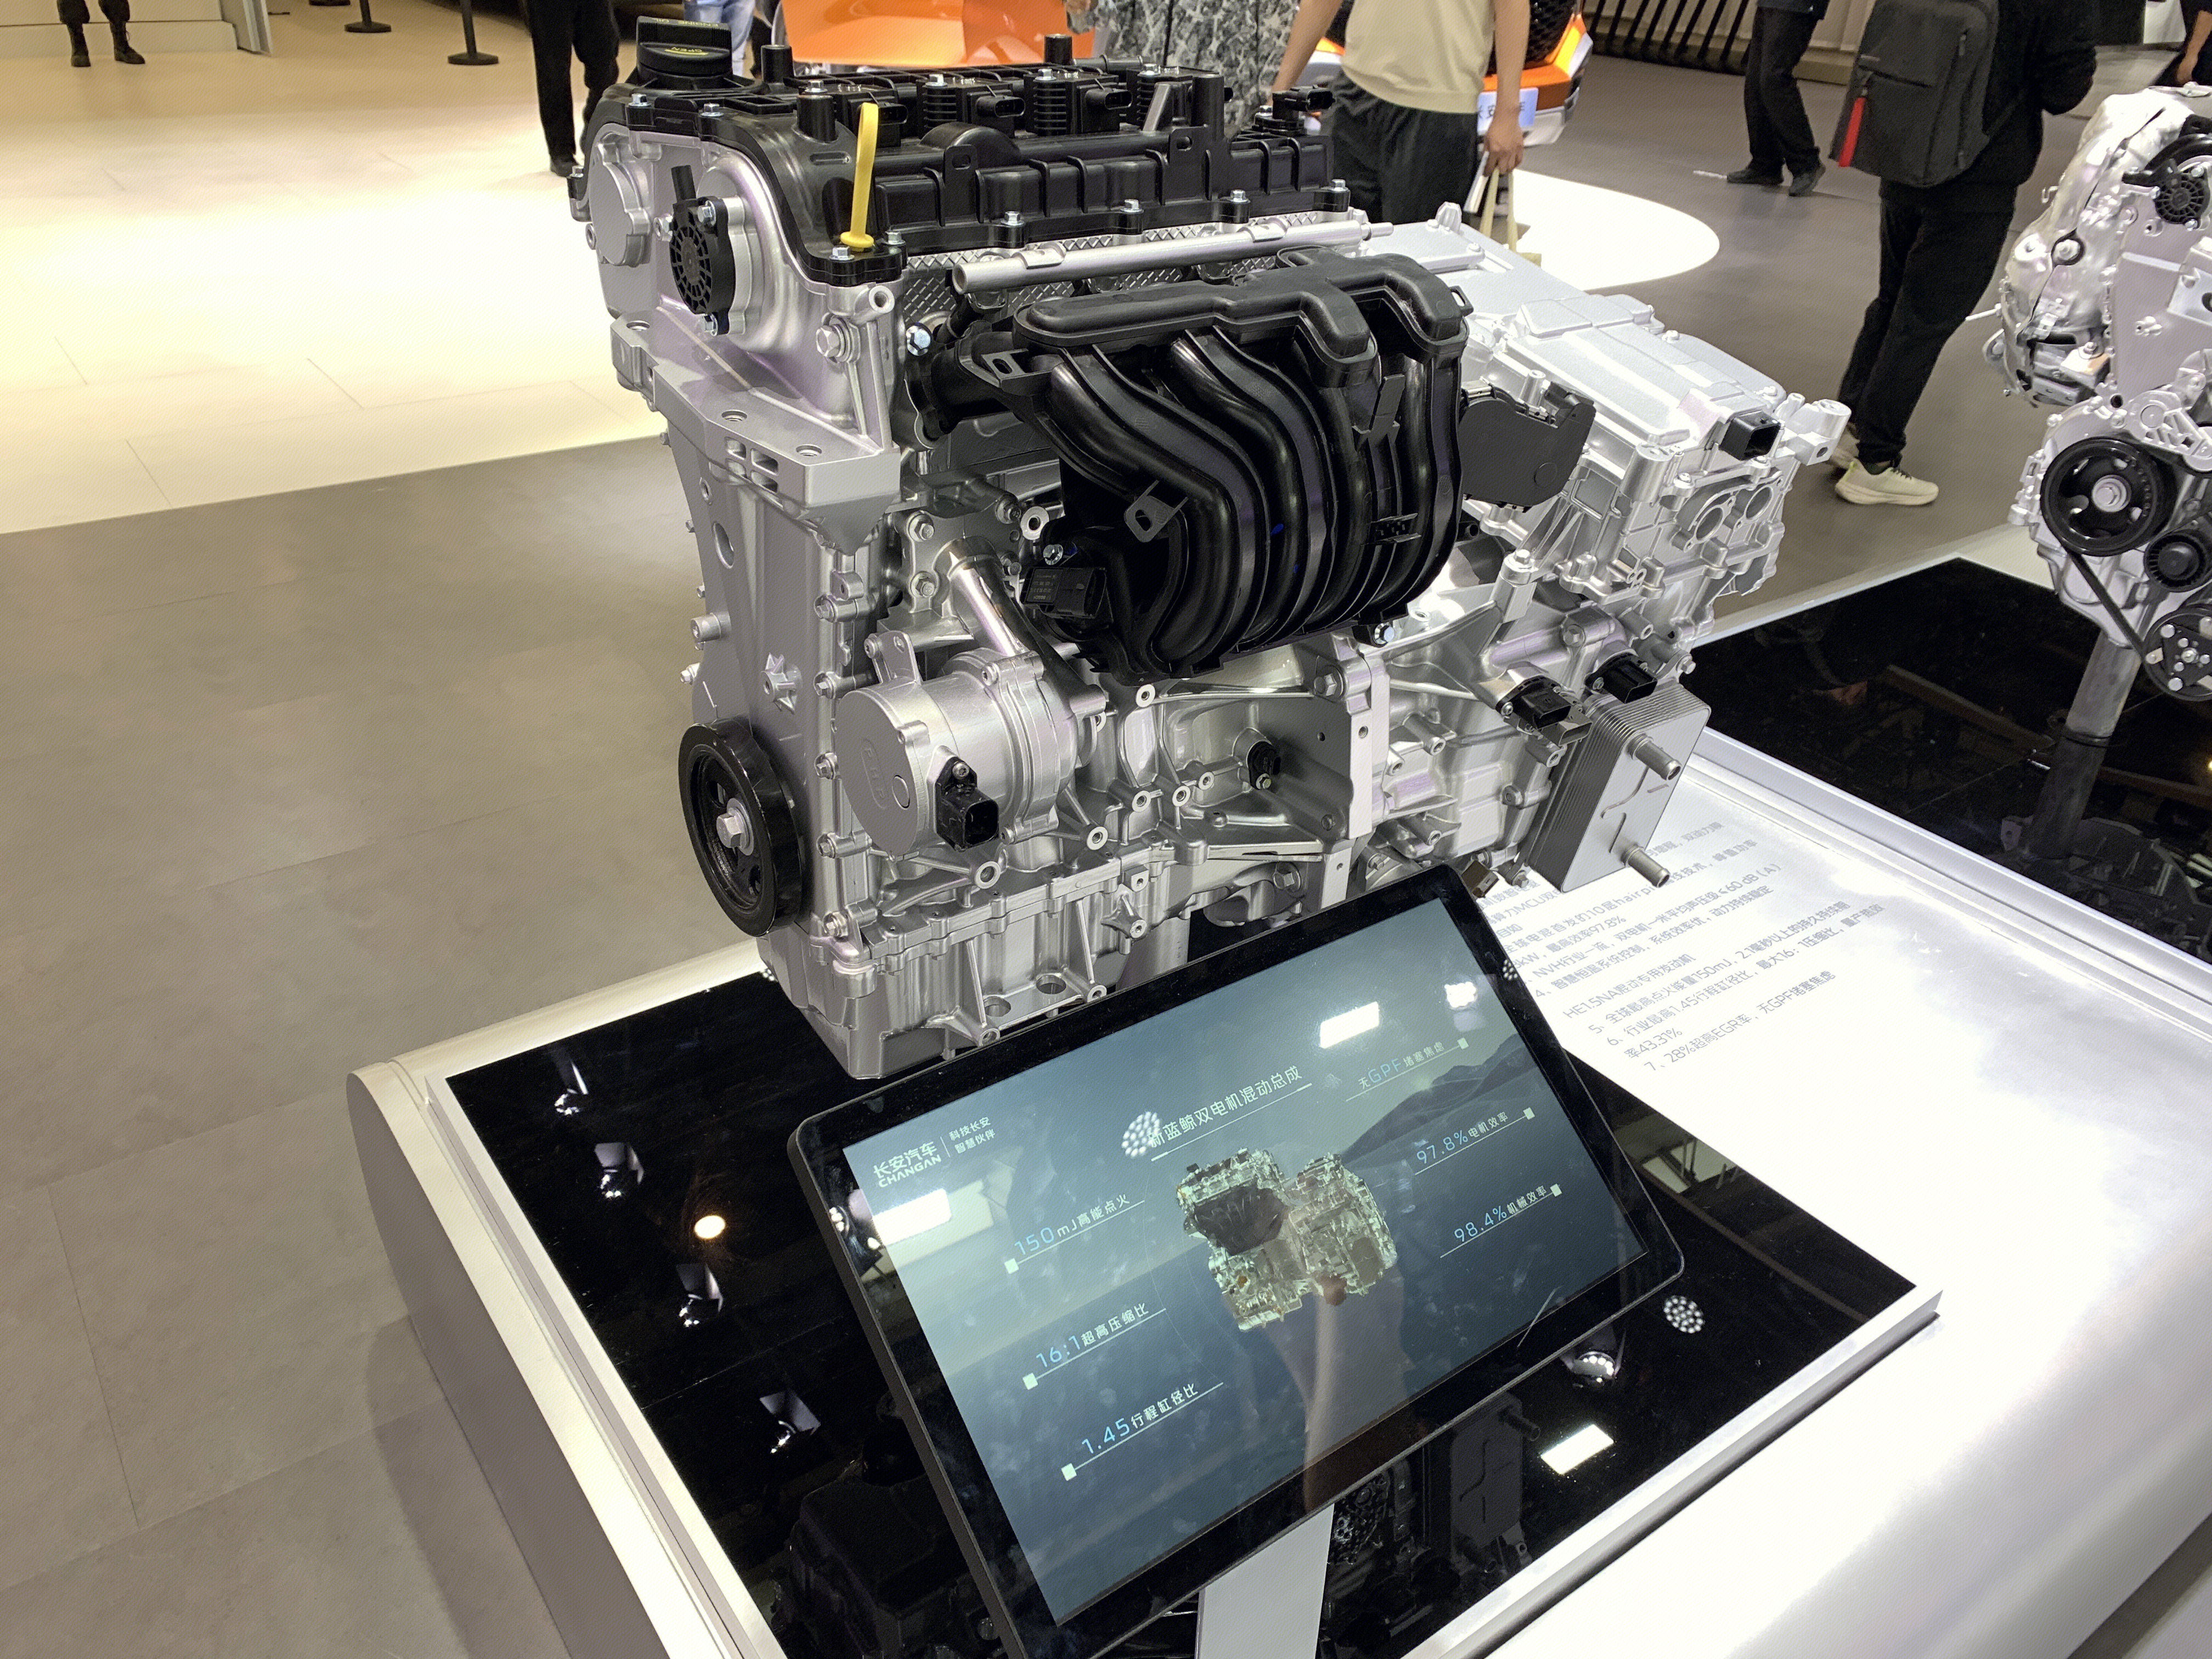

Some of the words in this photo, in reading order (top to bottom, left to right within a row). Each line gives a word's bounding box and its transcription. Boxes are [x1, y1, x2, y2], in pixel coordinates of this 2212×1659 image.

[1624, 1028, 1683, 1058] 率43.31%
[949, 1116, 991, 1141] 科技长安
[955, 1128, 996, 1154] 智慧伙伴
[873, 1141, 937, 1179] 长安汽车
[878, 1154, 941, 1188] CHANGAN
